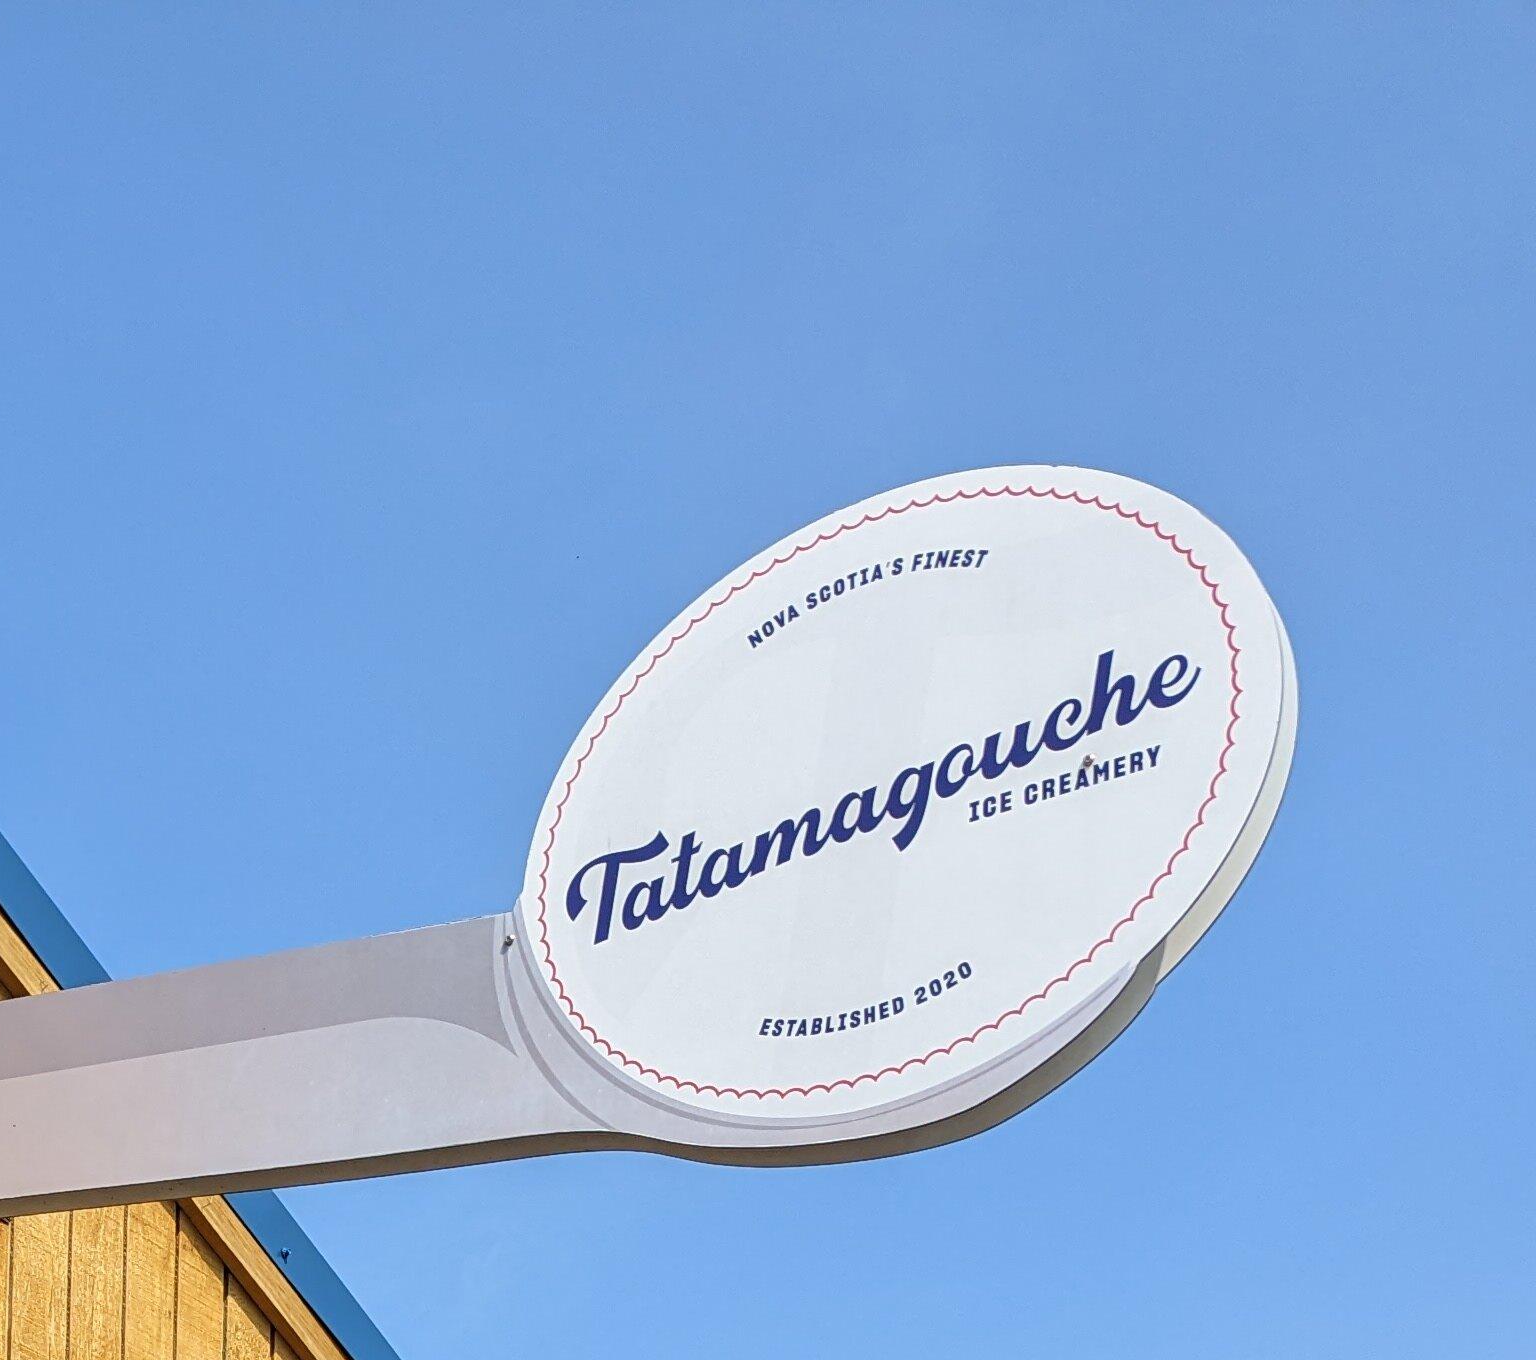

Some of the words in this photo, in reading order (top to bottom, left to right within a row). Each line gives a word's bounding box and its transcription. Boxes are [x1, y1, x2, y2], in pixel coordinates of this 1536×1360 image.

[747, 603, 801, 650] NOVA
[805, 555, 905, 612] SCOTIA'S
[910, 547, 990, 574] FINEST
[564, 648, 1202, 946] Tatamagouche
[967, 790, 1013, 824] ICE
[1022, 744, 1163, 807] CREAMERY
[757, 993, 906, 1038] ESTABLISHED
[913, 960, 974, 1007] 2020
